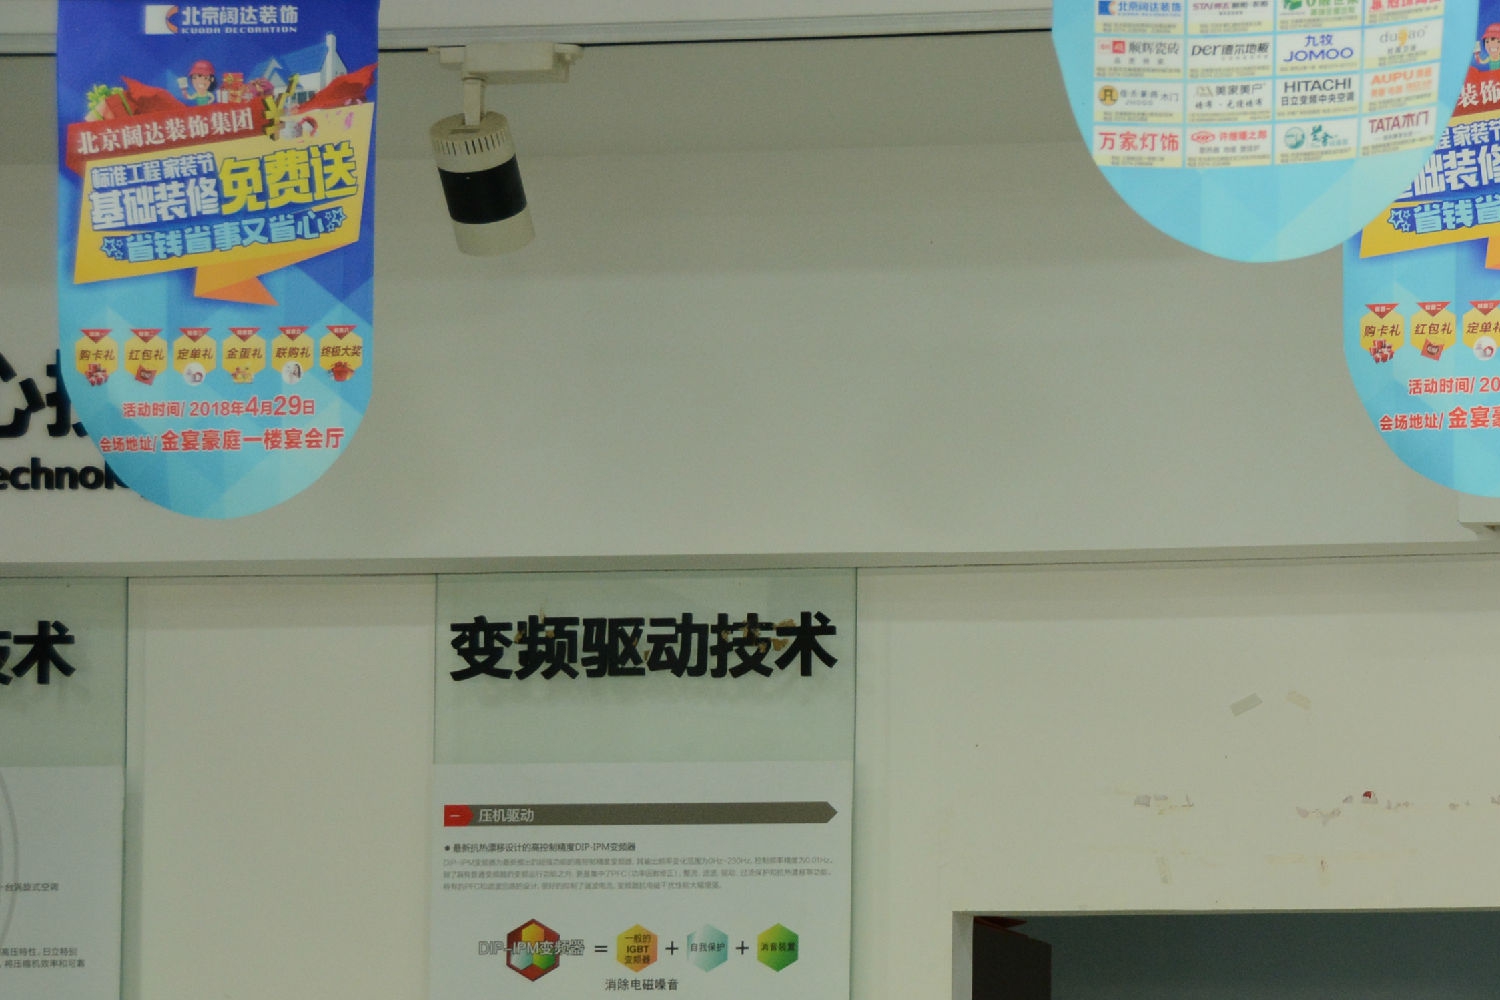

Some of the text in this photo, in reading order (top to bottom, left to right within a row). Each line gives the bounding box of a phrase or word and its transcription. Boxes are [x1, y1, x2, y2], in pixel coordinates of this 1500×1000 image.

[181, 5, 298, 25] 北京阔达装饰
[1305, 34, 1334, 48] 九牧
[1283, 47, 1354, 62] JOMOO
[1284, 77, 1351, 93] HITACHI
[1371, 70, 1415, 86] AUPU
[1281, 92, 1355, 106] 日立变频中央空调
[78, 106, 254, 155] 北京阔达装饰集团
[1369, 111, 1430, 134] TATA木门
[1098, 131, 1180, 152] 万家灯饰
[89, 141, 359, 231] 基础装修 免费送
[126, 208, 325, 263] 省钱省事又省心
[1364, 324, 1401, 337] 购卡礼
[1414, 323, 1453, 335] 红包礼
[128, 348, 165, 361] 红包礼
[177, 348, 214, 360] 定单礼
[226, 347, 263, 360] 金蛋礼
[320, 345, 363, 358] 终极大奖
[1408, 376, 1475, 395] 活动时间/
[123, 396, 315, 418] 活动时间/ 2018年4月29日
[1379, 411, 1444, 432] 会场地址/
[99, 427, 345, 452] 会场地址/ 金宴豪庭一楼宴会厅
[449, 611, 838, 681] 变频驱动技术
[478, 808, 535, 823] 压机驱动
[626, 945, 650, 954] IGBT
[604, 978, 679, 992] 消除电磁噪音
